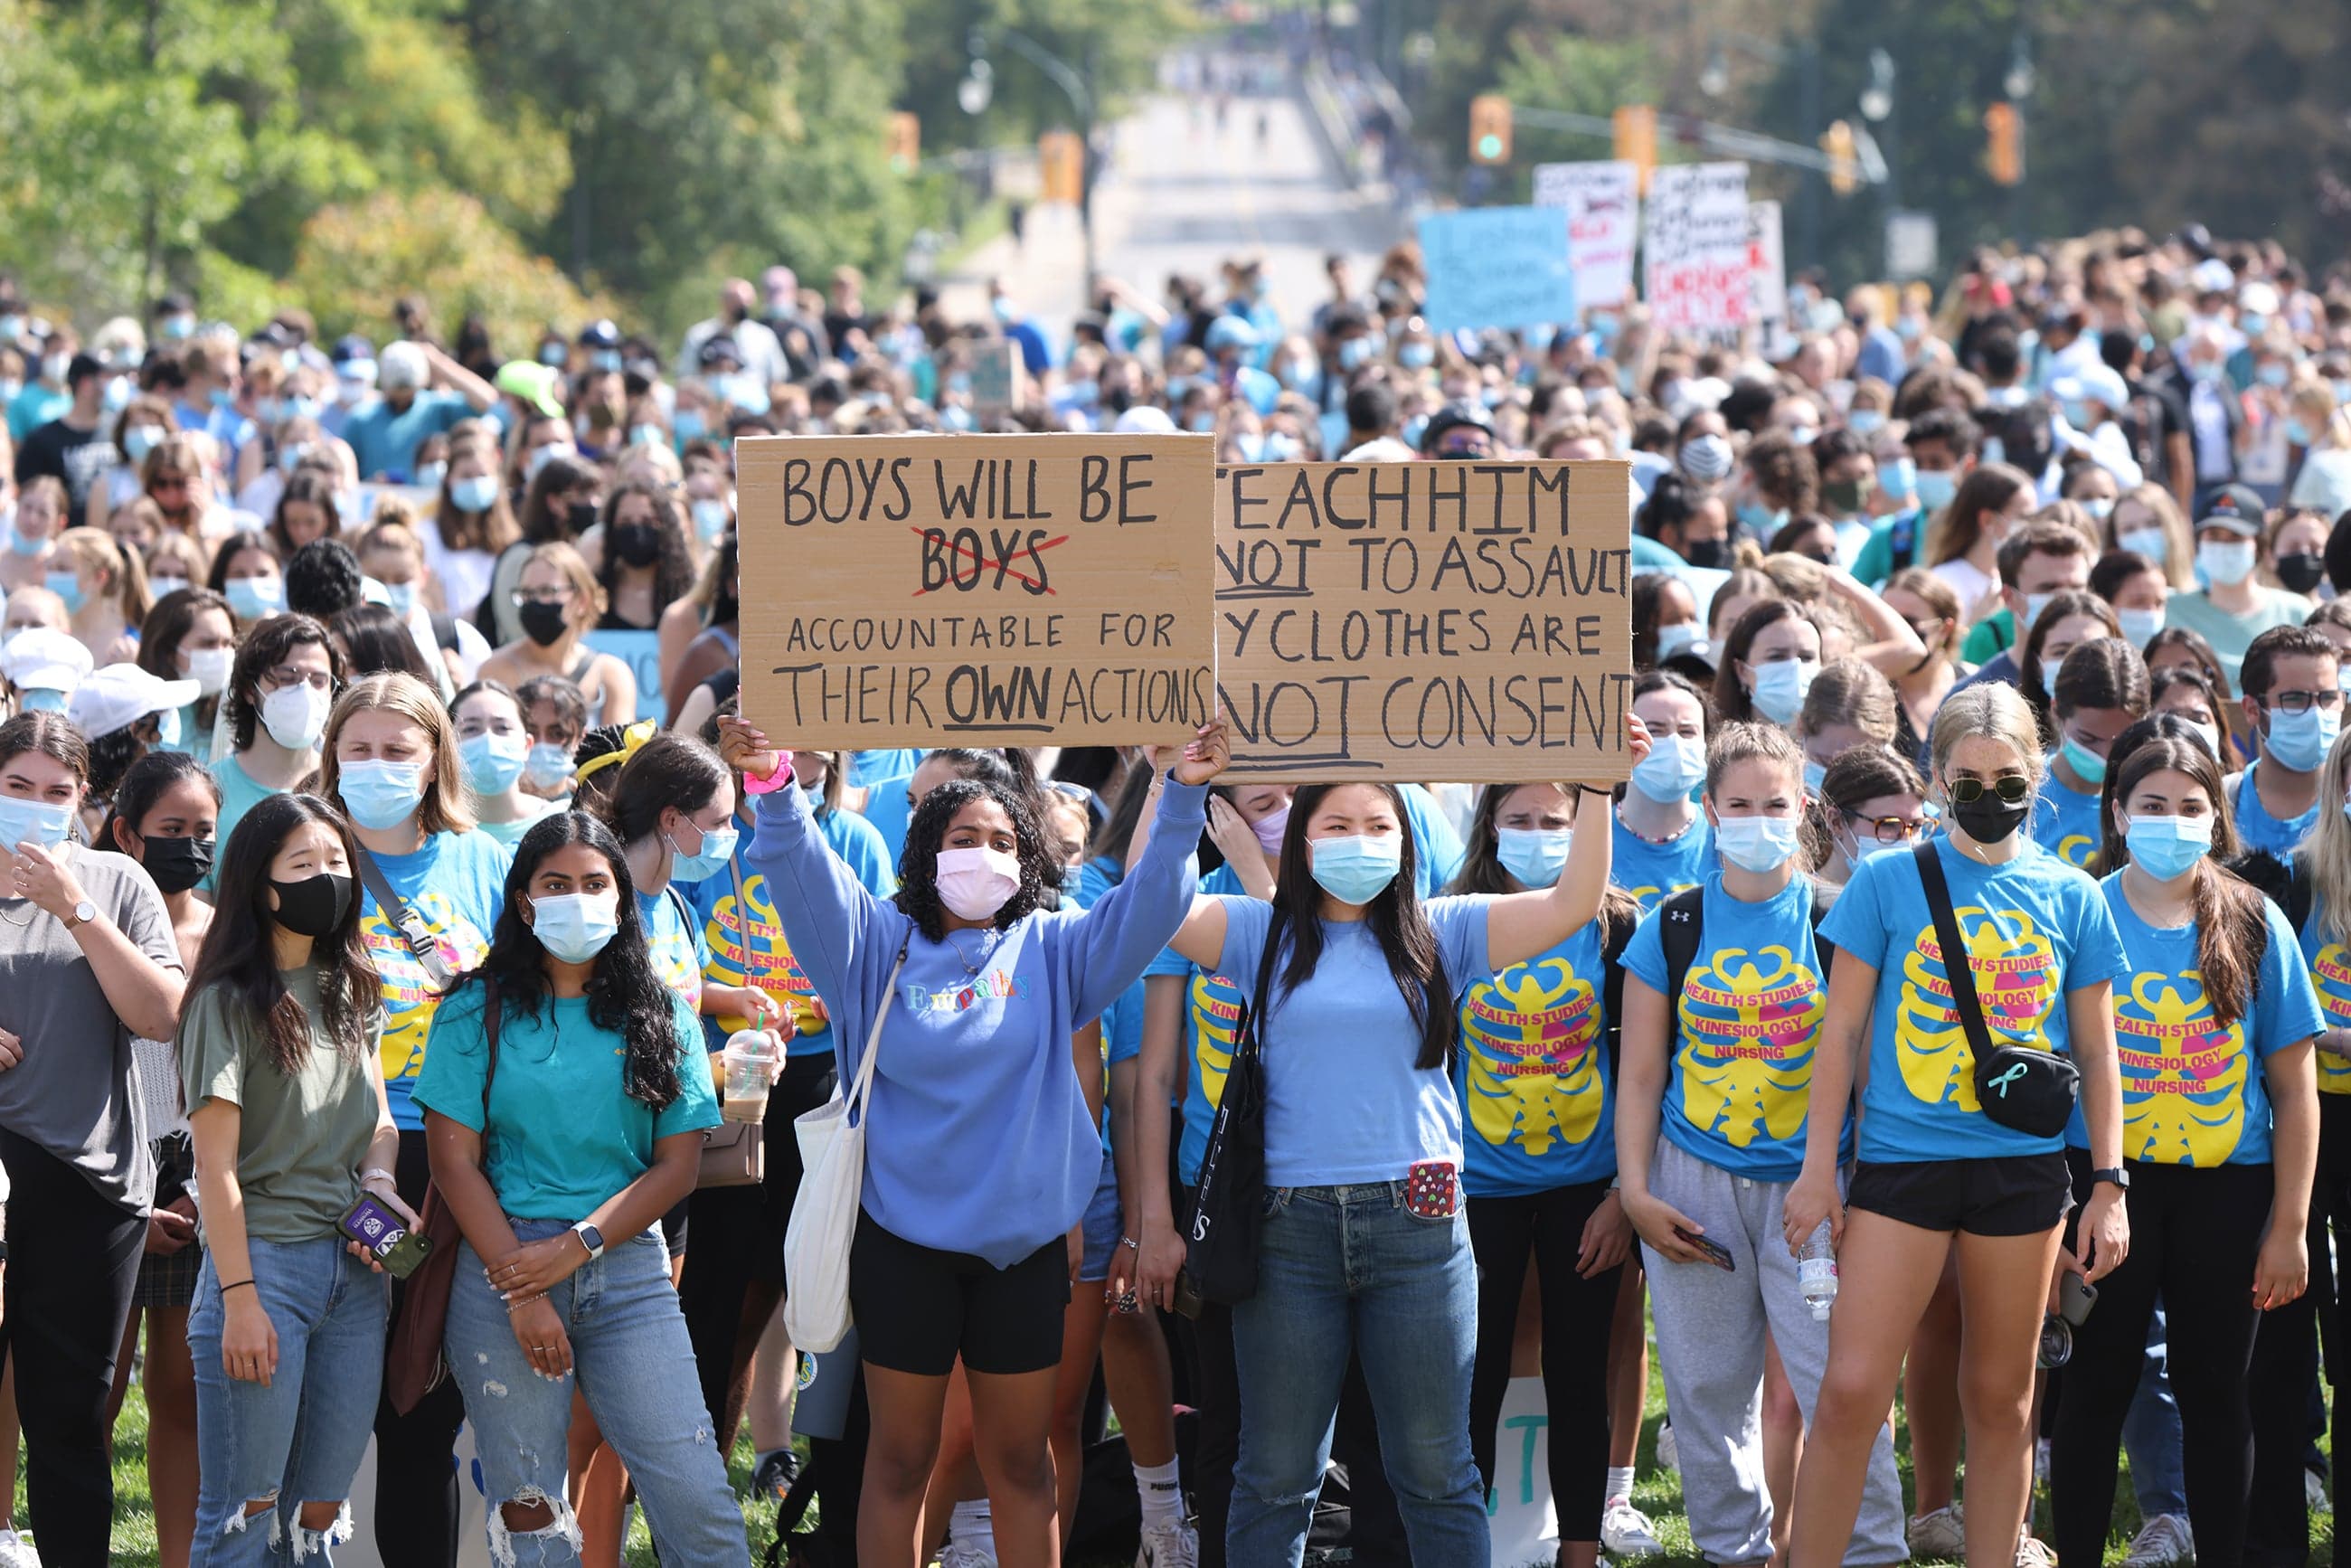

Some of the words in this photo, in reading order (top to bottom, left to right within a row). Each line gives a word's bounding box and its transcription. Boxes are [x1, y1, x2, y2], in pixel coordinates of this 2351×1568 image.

[784, 456, 912, 526] BOYS
[934, 458, 1053, 520] WILL
[1079, 454, 1158, 526] BE
[1216, 467, 1409, 532] EACH
[1428, 466, 1571, 536] HIM
[921, 527, 1049, 596] BOYS
[1216, 538, 1321, 591] NOT
[1349, 537, 1420, 594] TO
[1430, 535, 1631, 600] ASSAULT
[787, 614, 1064, 653] ACCOUNTABLE
[1100, 612, 1176, 648] FOR
[1223, 608, 1260, 657] Y
[1270, 609, 1491, 663] CLOTHES
[1511, 613, 1601, 657] ARE
[772, 662, 934, 729] THEIR
[944, 665, 1051, 724] OWN
[1059, 665, 1212, 729] ACTIONS
[1217, 675, 1370, 760] NOT
[1381, 672, 1633, 752] CONSENT
[725, 945, 798, 969] KIESIOL
[1985, 953, 2054, 973] STUDIES
[906, 968, 1029, 1013] Empathy
[1685, 980, 1744, 1007] HEALTH
[1746, 978, 1817, 1007] STUDIES
[1928, 977, 2037, 1006] KINIOLOGY
[1468, 997, 1528, 1025] HEALTH
[1531, 992, 1594, 1025] STUDIES
[1695, 1016, 1803, 1039] KINESIOLOGY
[2114, 1015, 2167, 1038] EALTH
[1481, 1031, 1582, 1057] KINESIOLOGY
[1714, 1044, 1786, 1060] NURSING
[1496, 1062, 1570, 1076] NURSING
[2118, 1047, 2222, 1071] KINESIOLOGY
[2133, 1078, 2207, 1094] NURSING
